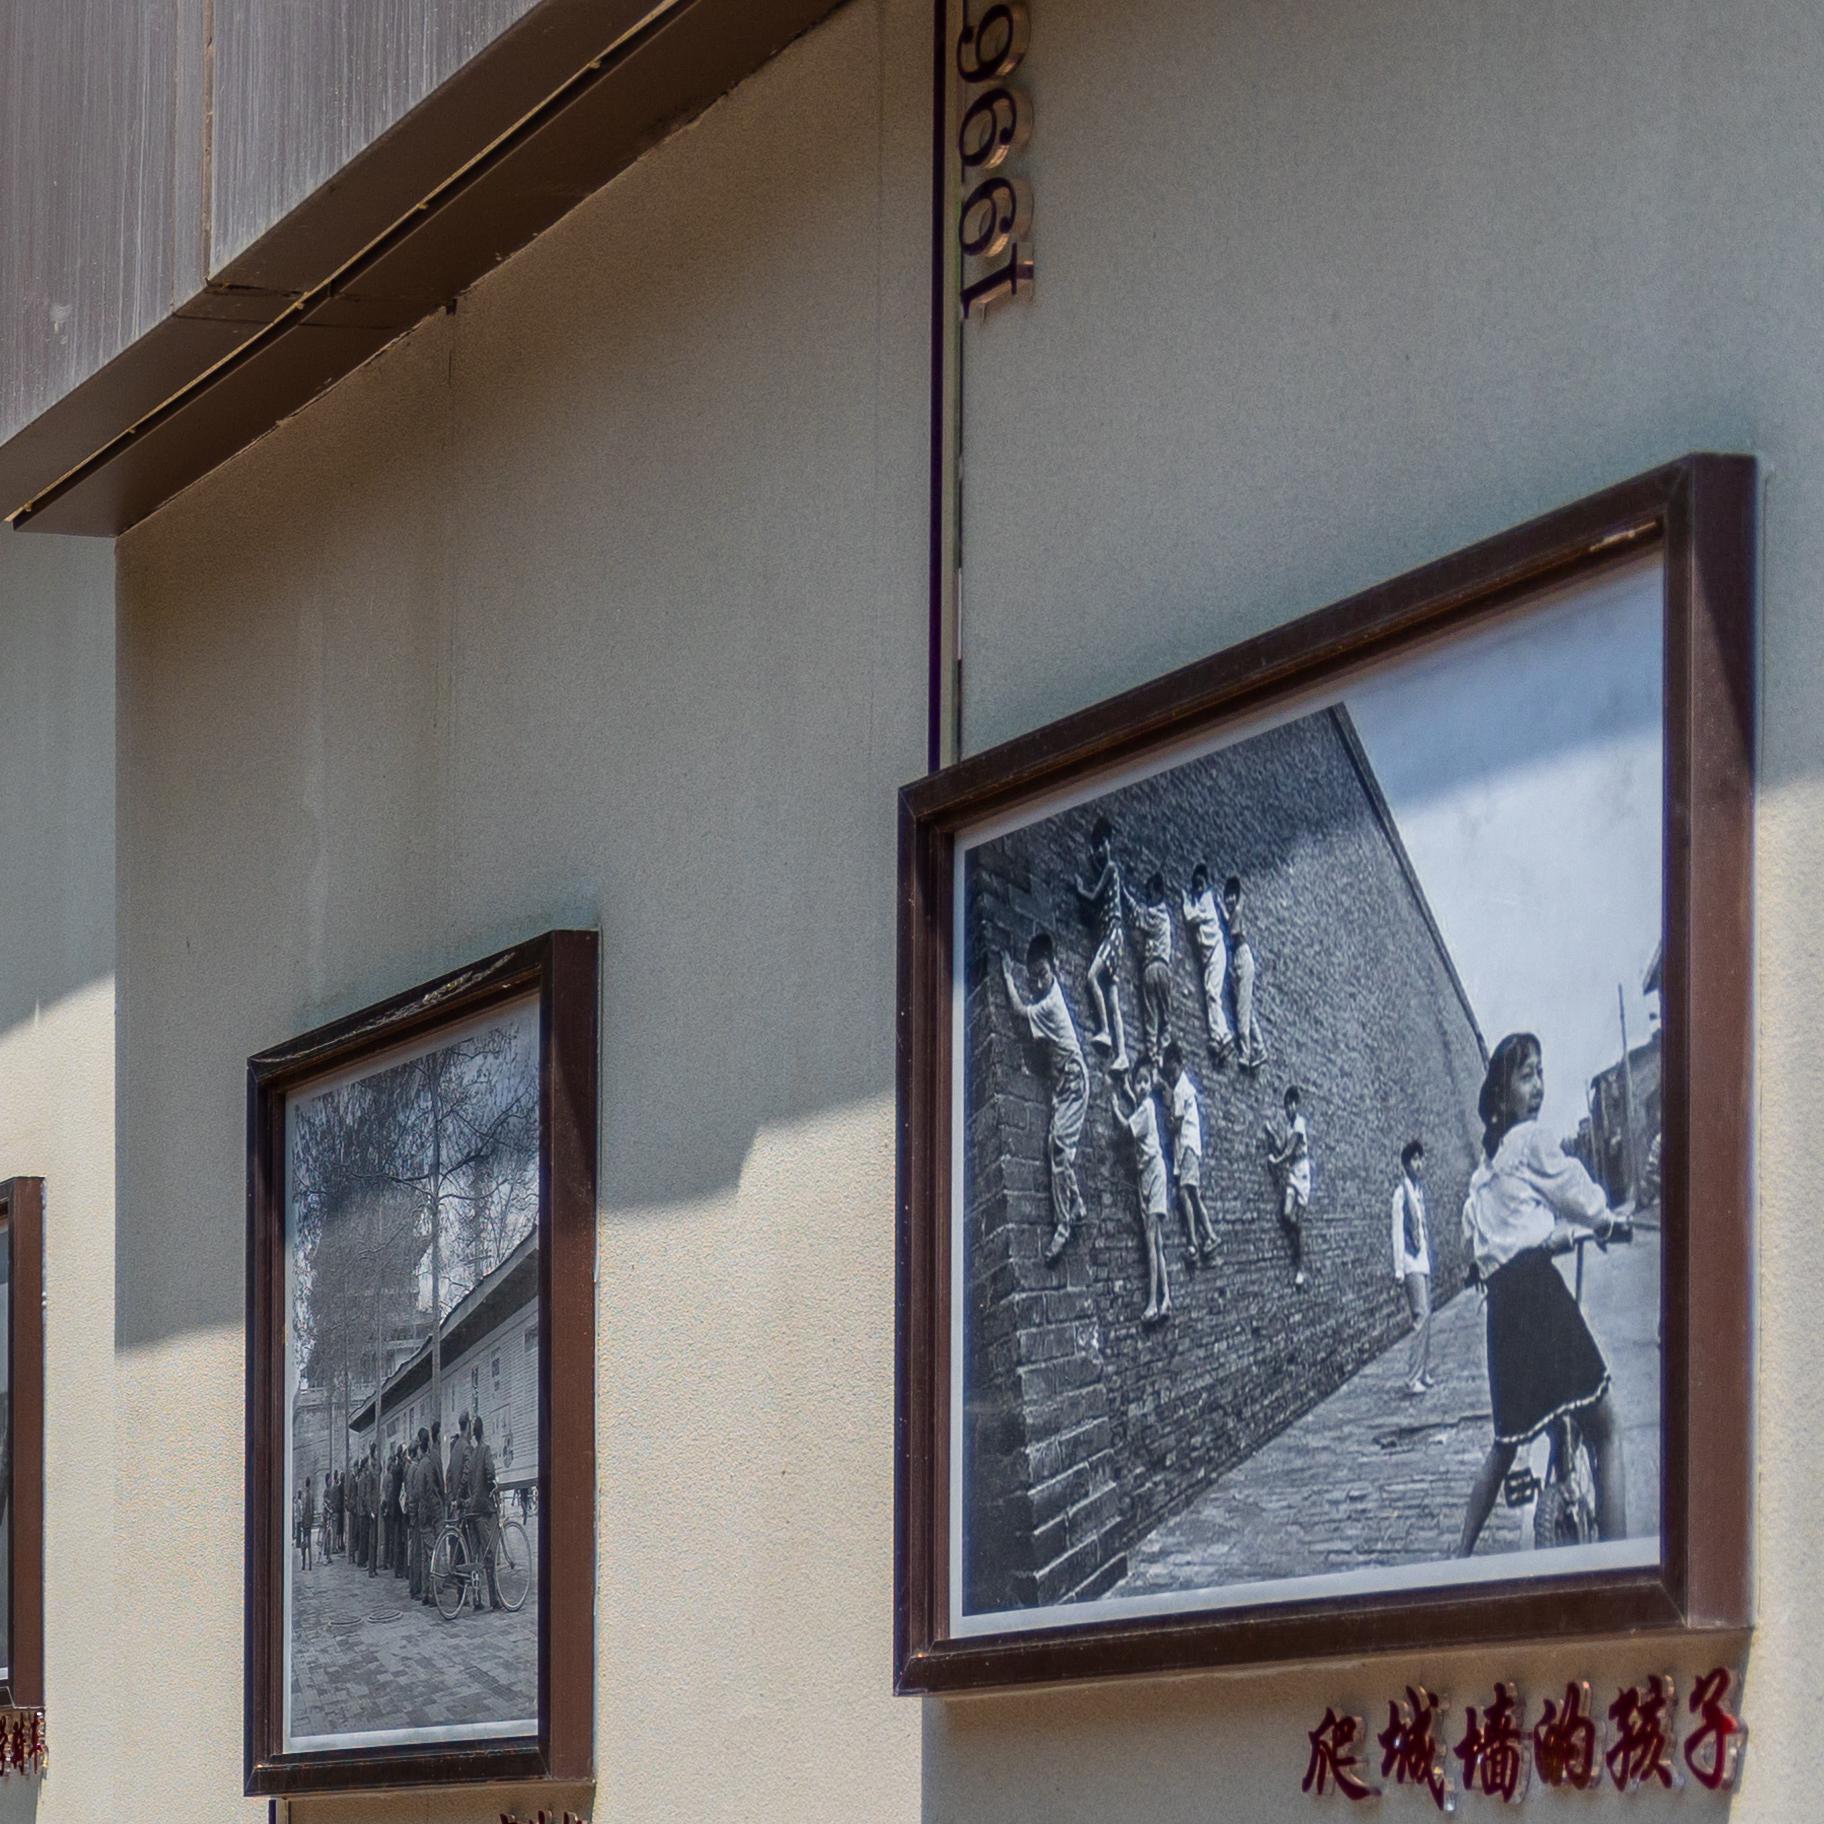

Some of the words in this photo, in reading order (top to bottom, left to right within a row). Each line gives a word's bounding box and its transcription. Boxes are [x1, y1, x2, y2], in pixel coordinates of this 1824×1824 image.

[1300, 1666, 1740, 1811] 爬城墙的孩子
